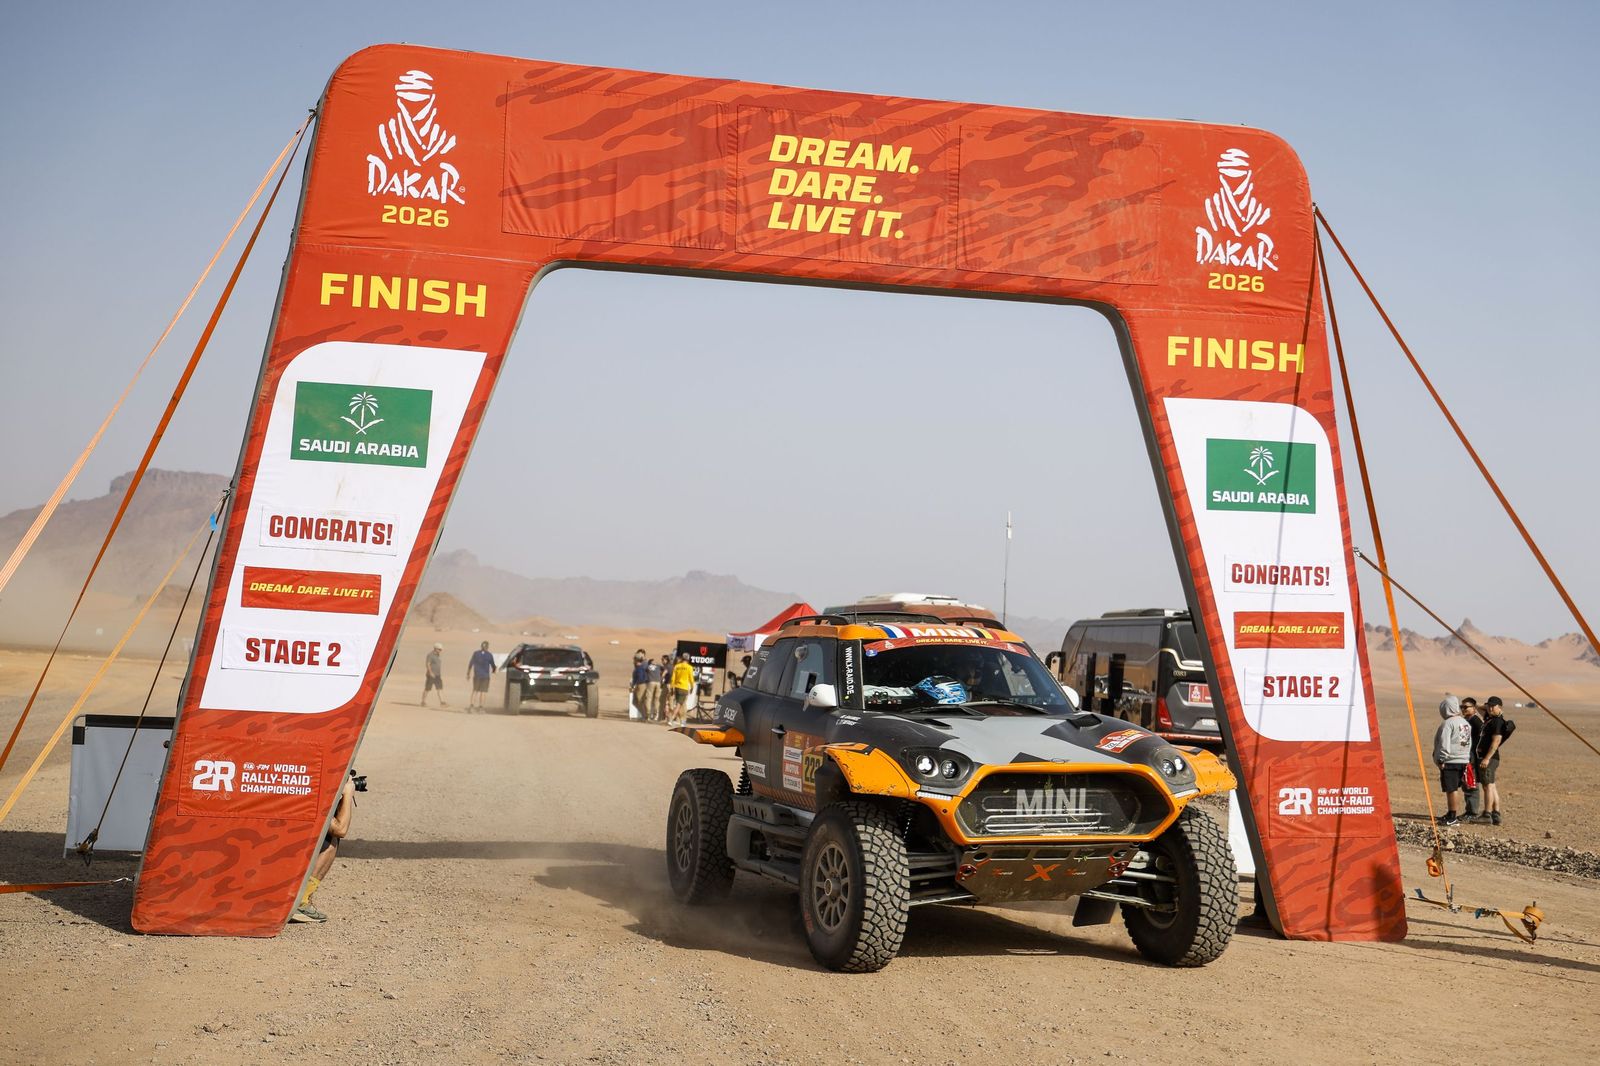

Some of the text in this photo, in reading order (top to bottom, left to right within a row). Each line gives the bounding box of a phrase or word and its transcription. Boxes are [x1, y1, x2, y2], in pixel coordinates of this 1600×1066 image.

[769, 134, 919, 174] DREAM.
[367, 154, 465, 204] DAKAR
[768, 168, 883, 204] DARE.
[382, 205, 449, 227] 2026
[767, 202, 904, 239] LIVE IT.
[1195, 226, 1278, 271] DAKAR
[1208, 272, 1265, 292] 2026
[320, 272, 487, 317] FINISH
[1168, 335, 1304, 373] FINISH
[300, 438, 419, 458] SAUDI ARABIA
[1212, 490, 1310, 505] SAUDI ARABIA
[269, 515, 393, 546] CONGRATS!
[1231, 563, 1330, 586] CONGRATS!
[249, 582, 374, 598] DREAM. DARE. LIVE IT.
[911, 627, 979, 638] MINI
[1239, 625, 1339, 634] DREAM. DARE. LIVE IT.
[245, 637, 341, 667] STAGE 2
[691, 656, 714, 664] TUDOR
[1263, 675, 1339, 698] STAGE 2
[273, 763, 307, 773] WORLD
[240, 784, 311, 795] CHAMPIONSHIP
[241, 772, 310, 786] RALLY-RAID
[1016, 788, 1086, 815] MINI
[1318, 796, 1373, 806] RALLY-RAID
[1342, 787, 1368, 795] WORLD
[1318, 806, 1374, 815] CHAMPIONSHIP
